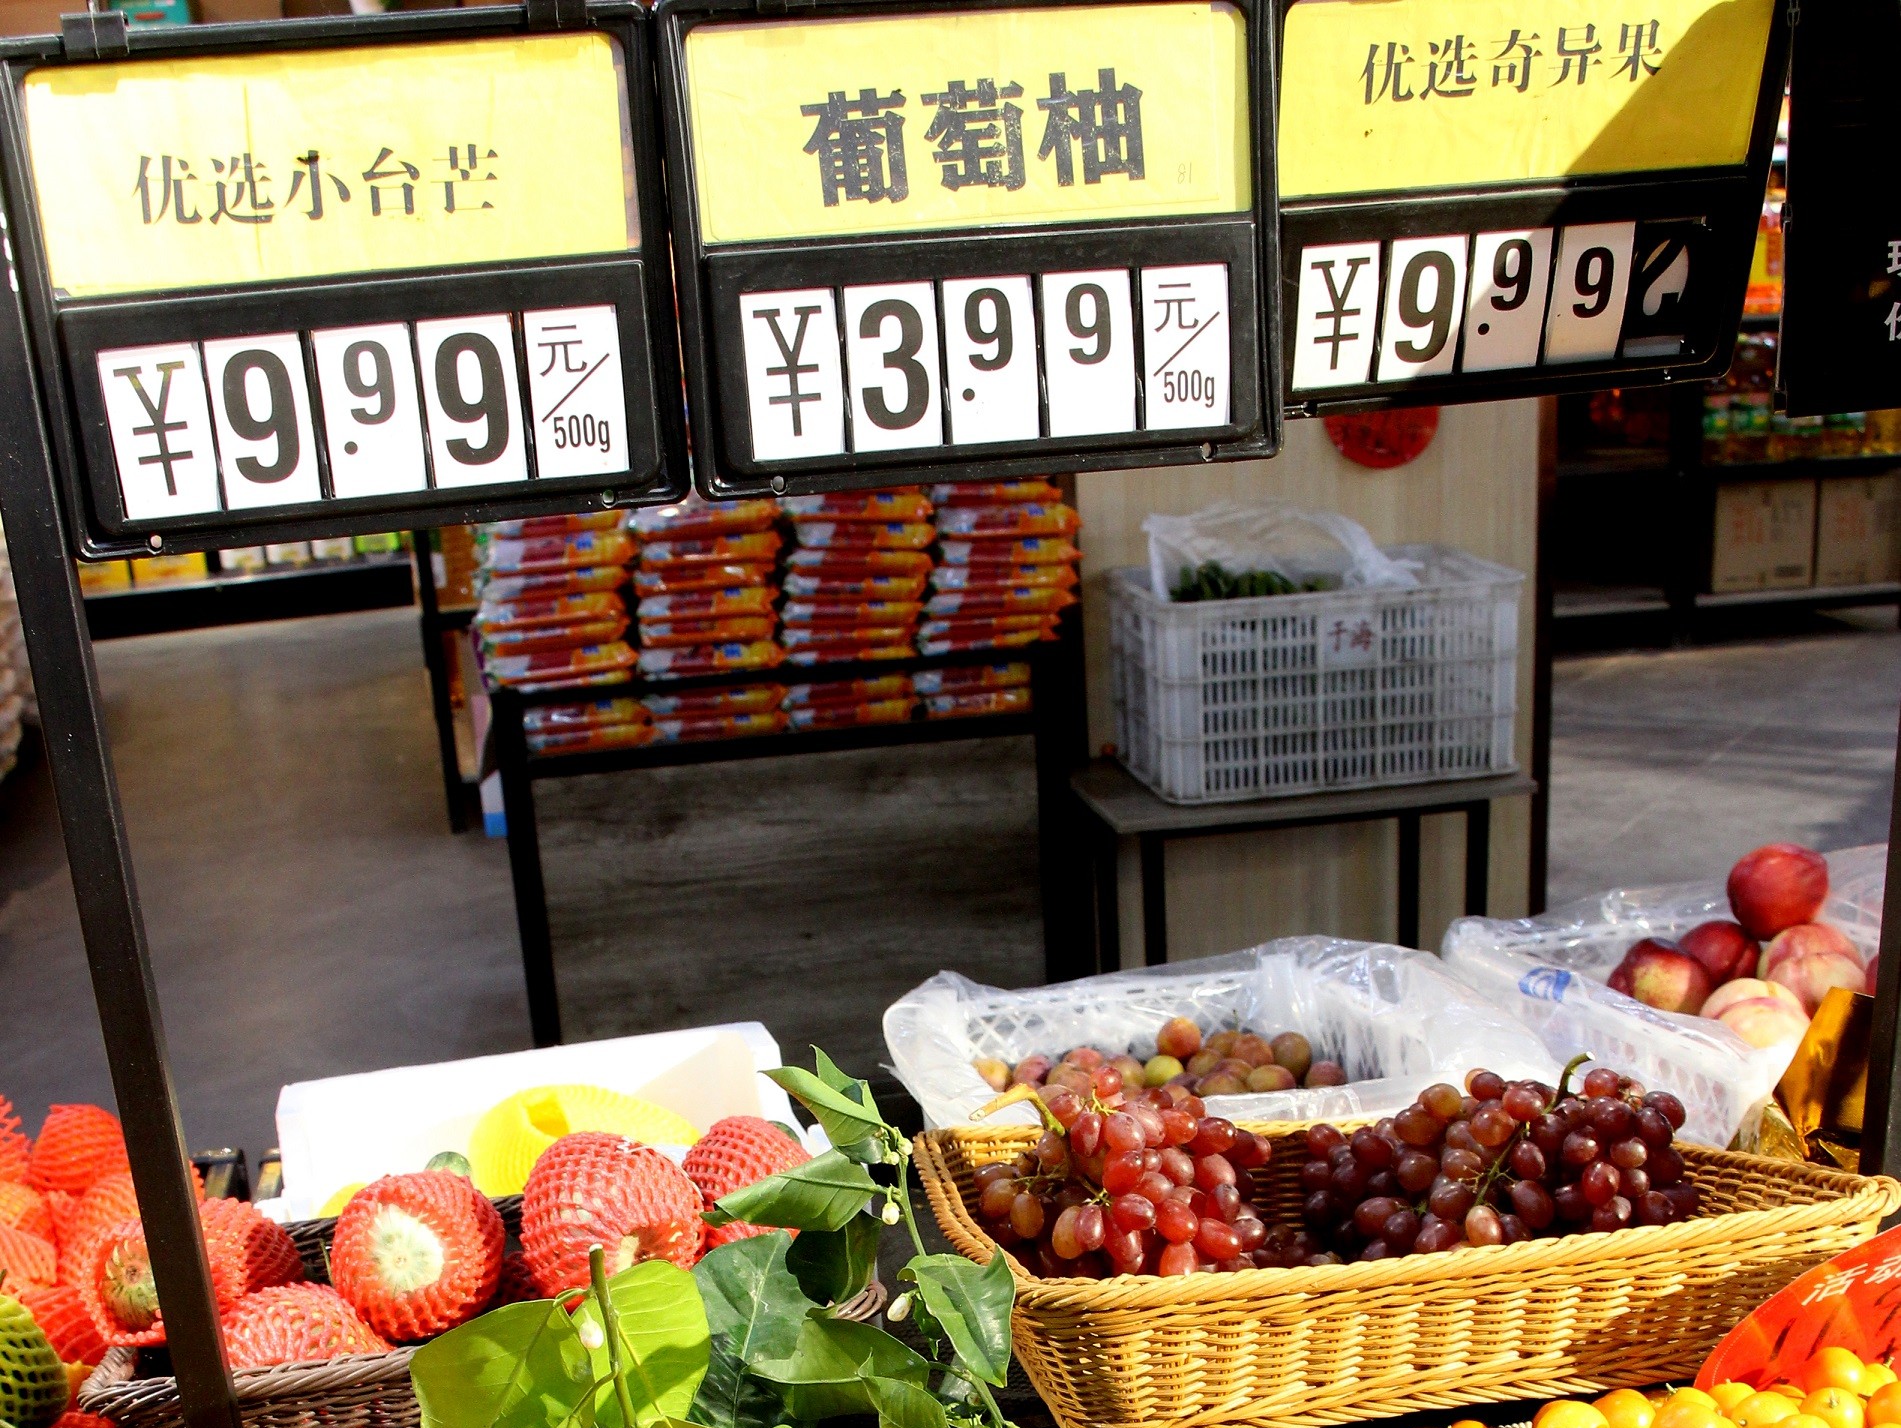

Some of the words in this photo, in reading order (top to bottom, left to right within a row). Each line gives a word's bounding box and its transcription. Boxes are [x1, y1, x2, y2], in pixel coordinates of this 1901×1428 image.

[1358, 18, 1665, 107] 优选奇异果
[800, 67, 1147, 208] 葡萄柚
[133, 143, 500, 226] 优选小台芒
